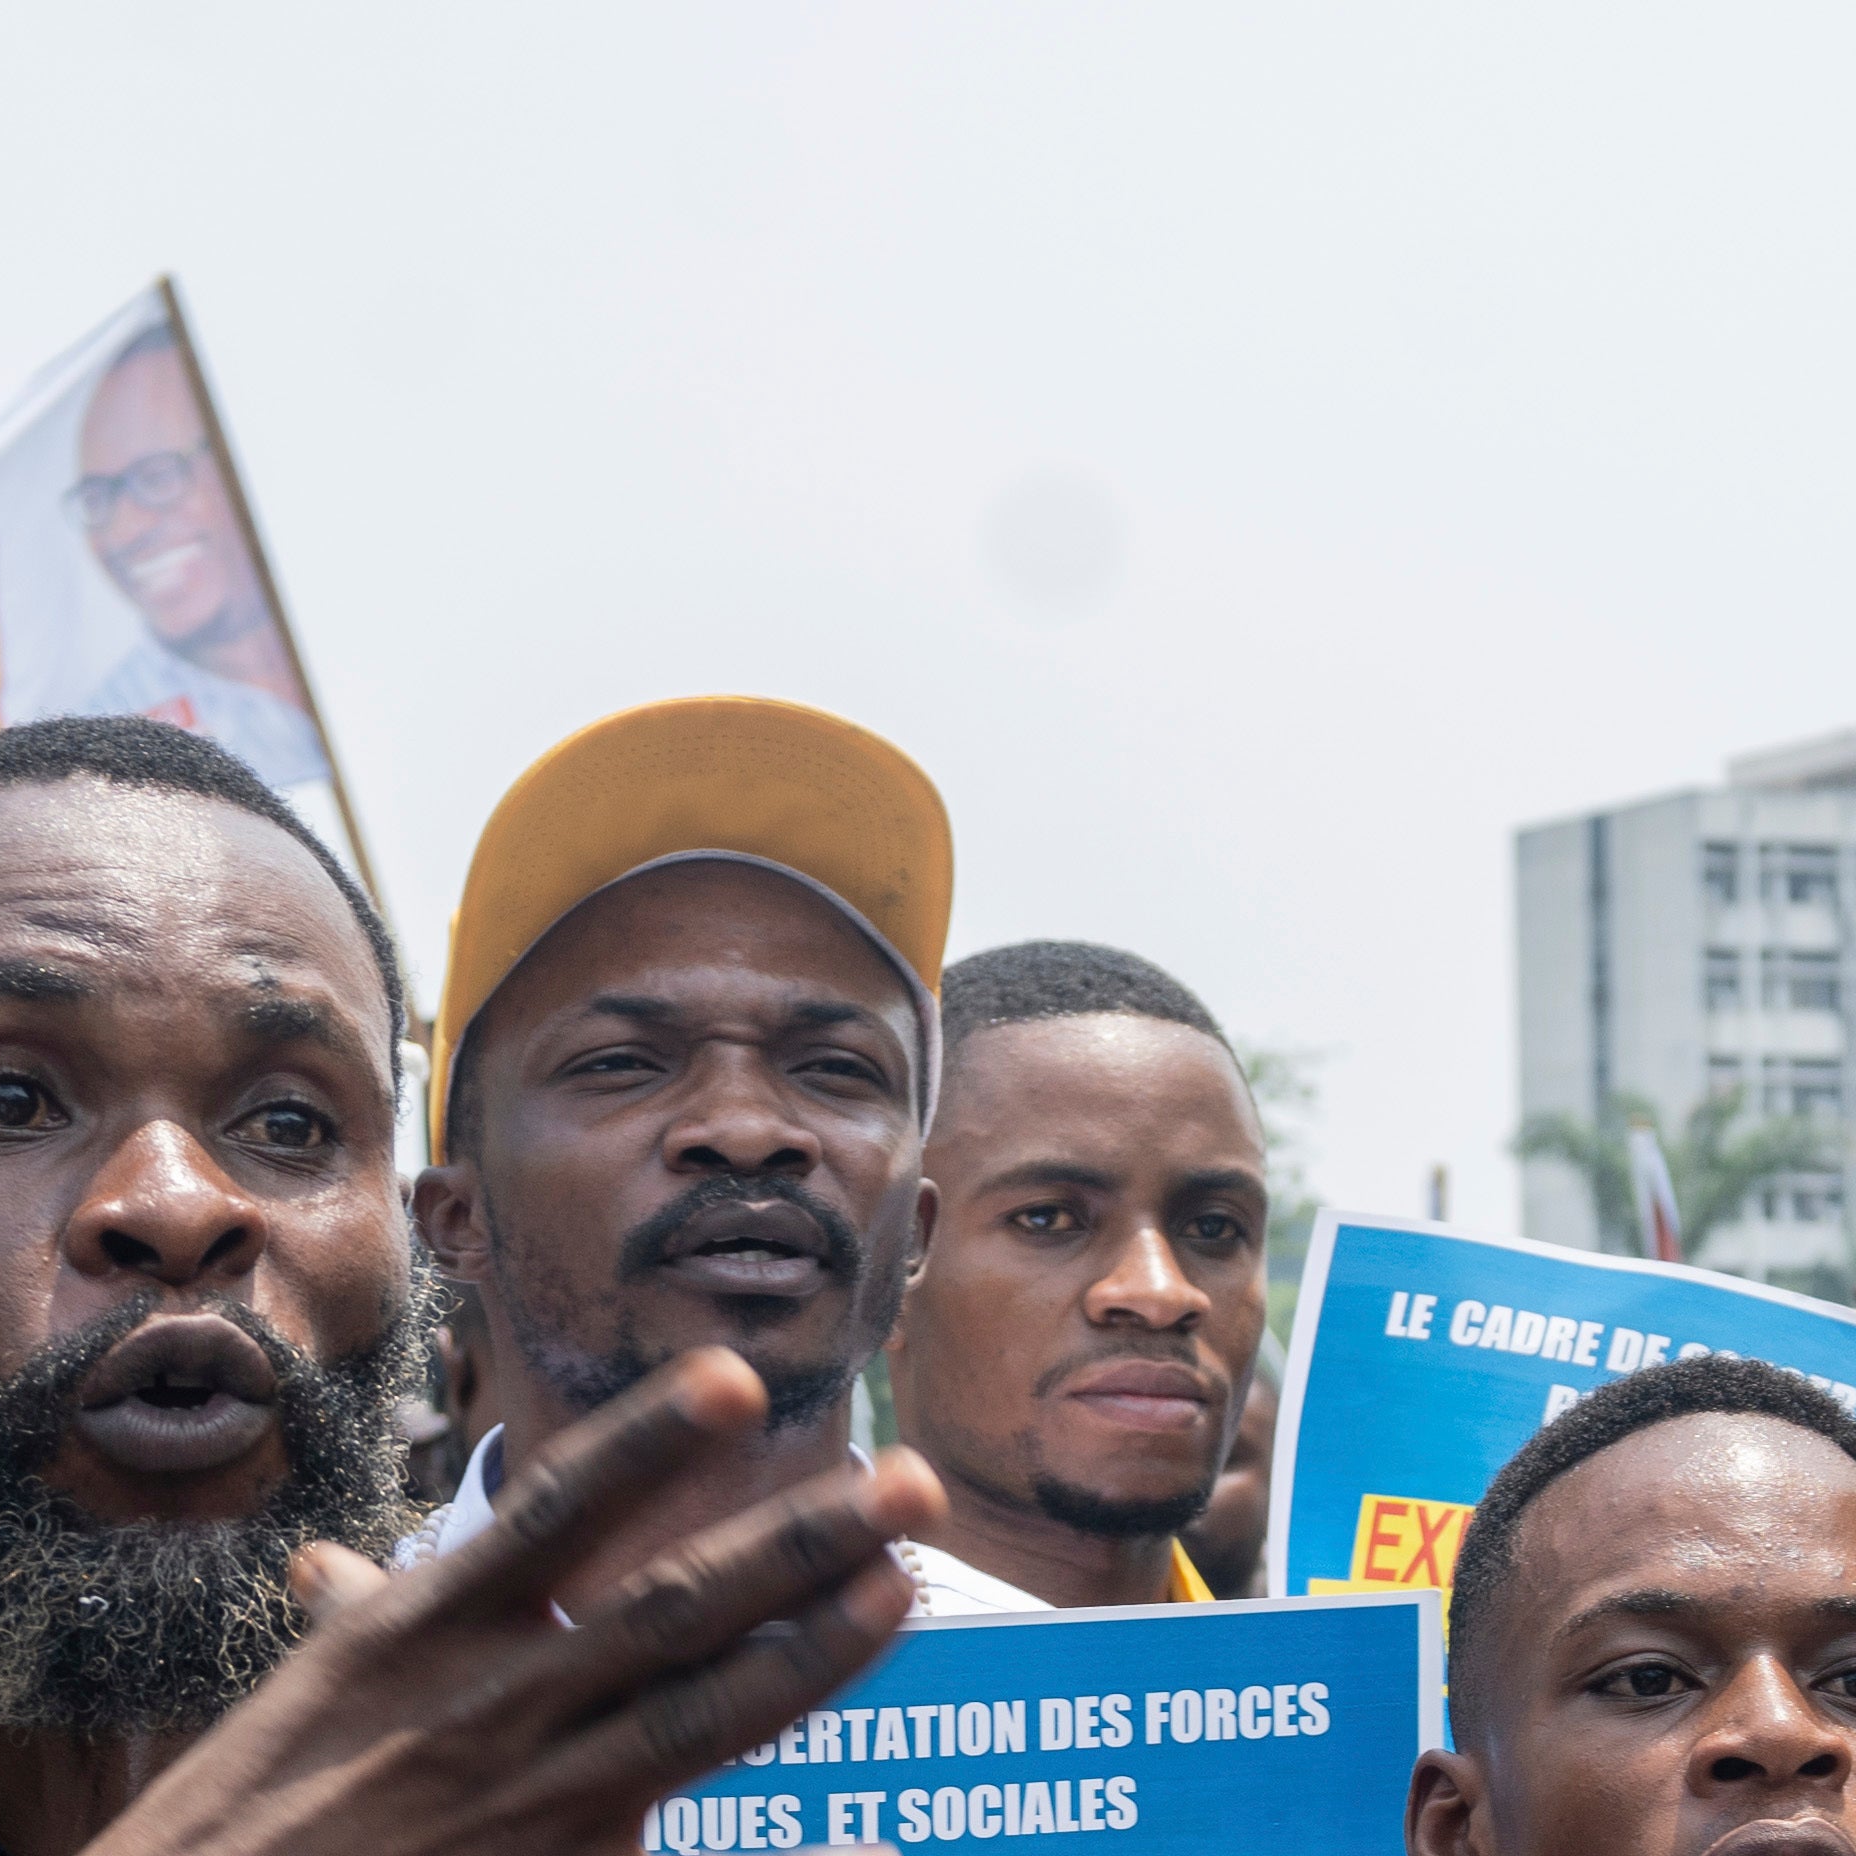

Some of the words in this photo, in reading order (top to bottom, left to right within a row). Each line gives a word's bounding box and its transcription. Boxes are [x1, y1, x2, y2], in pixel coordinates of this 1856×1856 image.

[1384, 1291, 1438, 1340] LE
[1448, 1299, 1605, 1368] CADRE
[1604, 1326, 1672, 1374] DE
[1040, 1692, 1134, 1751] DES
[1145, 1681, 1332, 1746] FORCES
[643, 1793, 804, 1856] IQUES
[827, 1790, 887, 1846] ET
[897, 1775, 1139, 1848] SOCIALES
